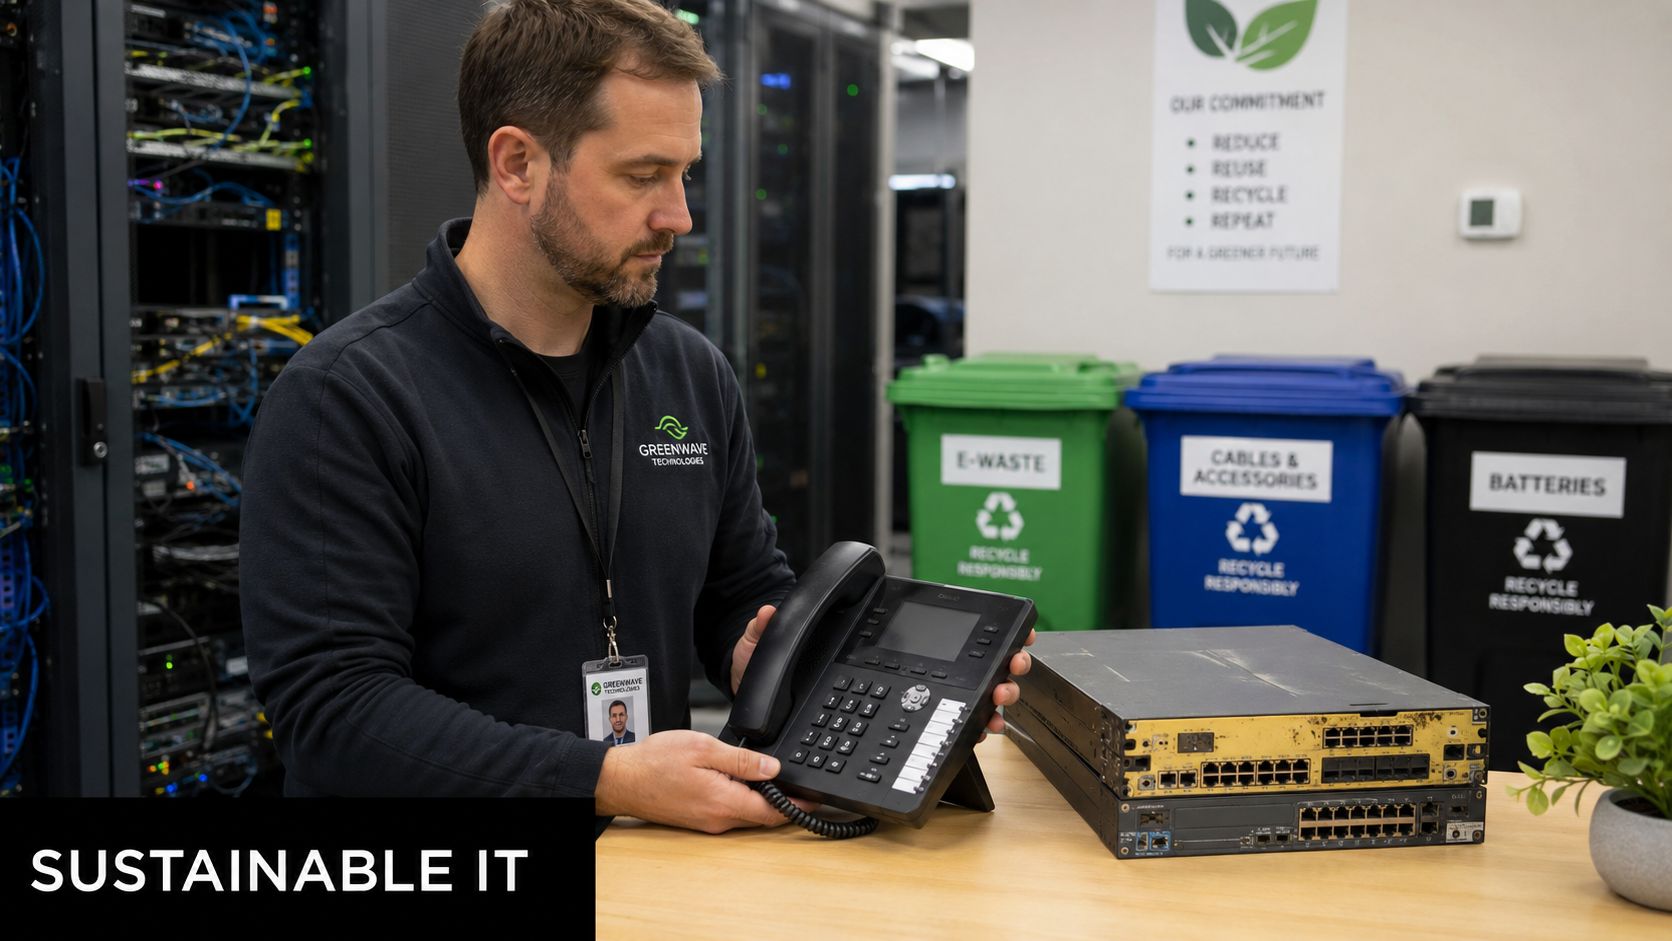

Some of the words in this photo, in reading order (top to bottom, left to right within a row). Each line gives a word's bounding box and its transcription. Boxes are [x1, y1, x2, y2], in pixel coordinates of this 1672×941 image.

[1170, 95, 1203, 113] OUR
[1209, 90, 1324, 112] COMMITMENT
[1212, 134, 1279, 151] REDUCE
[1212, 160, 1265, 177] REUSE
[1211, 187, 1287, 204] RECYCLE
[1211, 212, 1274, 229] REPEAT
[639, 443, 708, 456] GREENWAVE
[1211, 449, 1281, 468] CABLES
[1287, 452, 1299, 469] &
[957, 450, 1046, 473] E-WASTE
[1194, 469, 1318, 490] ACCESSORIES
[1489, 473, 1607, 497] BATTERIES
[969, 545, 1030, 564] RECYCLE
[1218, 558, 1285, 578] RECYCLE
[1504, 576, 1579, 597] RECYCLE
